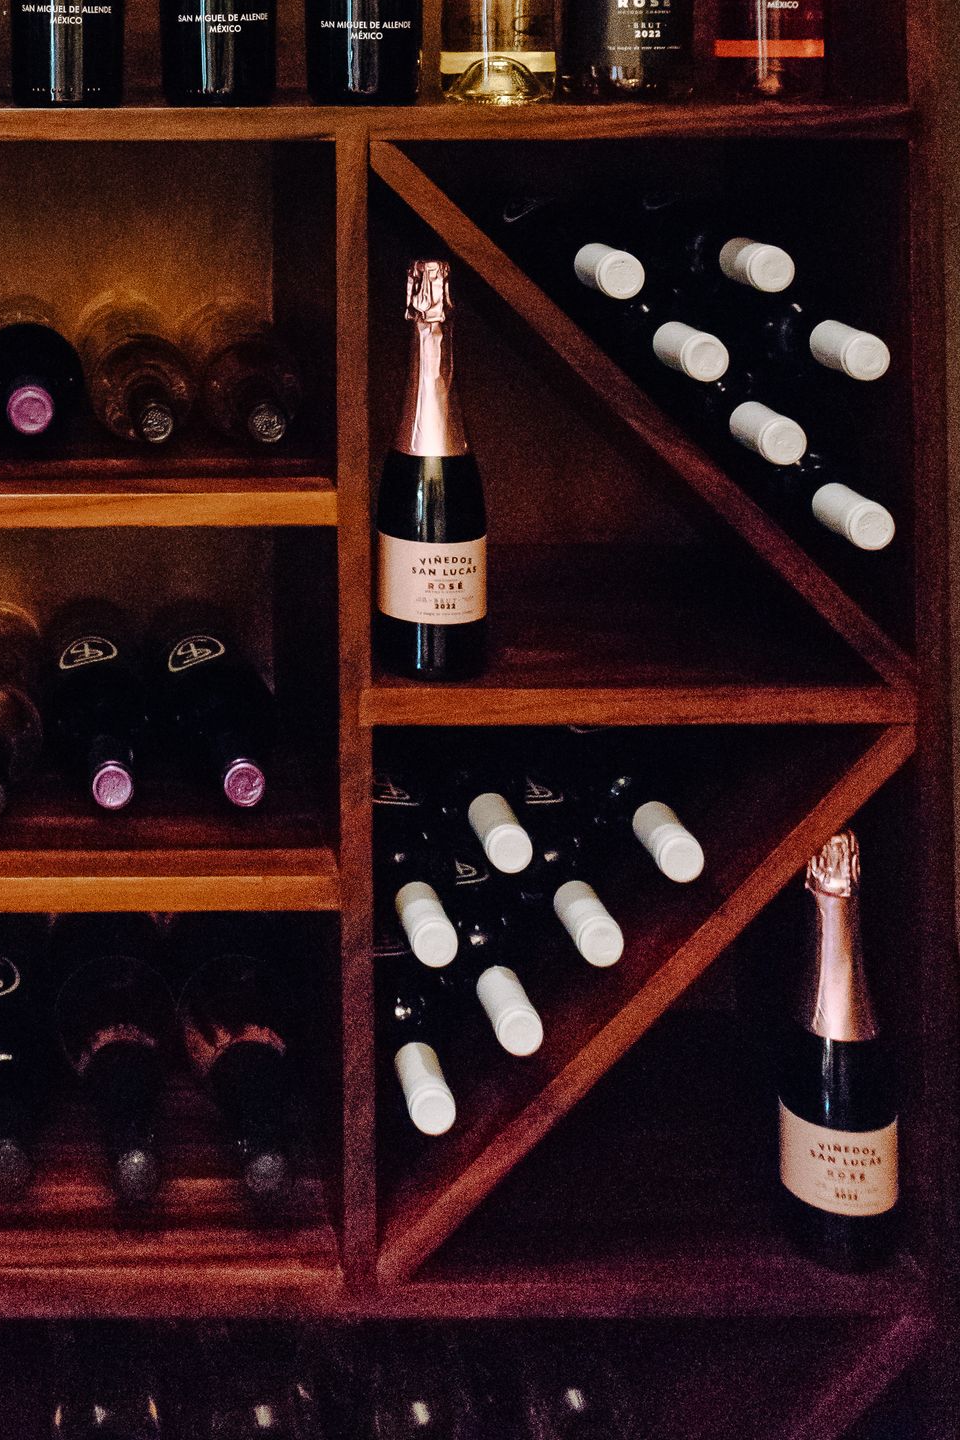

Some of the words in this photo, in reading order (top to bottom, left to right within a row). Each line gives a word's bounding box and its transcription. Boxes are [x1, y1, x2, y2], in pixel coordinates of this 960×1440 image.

[22, 4, 35, 12] SAN
[37, 5, 66, 13] MIGUEL
[81, 6, 112, 14] ALLENDE
[767, 0, 799, 9] MÉXICO
[228, 14, 239, 22] DE
[240, 13, 268, 21] ALLENDE
[209, 23, 242, 33] MÉXICO
[336, 21, 368, 29] MIGUEL
[382, 21, 411, 29] ALLENDE
[350, 30, 384, 40] MÉXICO
[635, 30, 661, 38] 2022
[420, 555, 472, 565] VIÑEDOS
[412, 566, 436, 576] SAN
[443, 565, 477, 576] LUCAS
[428, 581, 463, 590] ROSÉ
[810, 1149, 836, 1164] SAN
